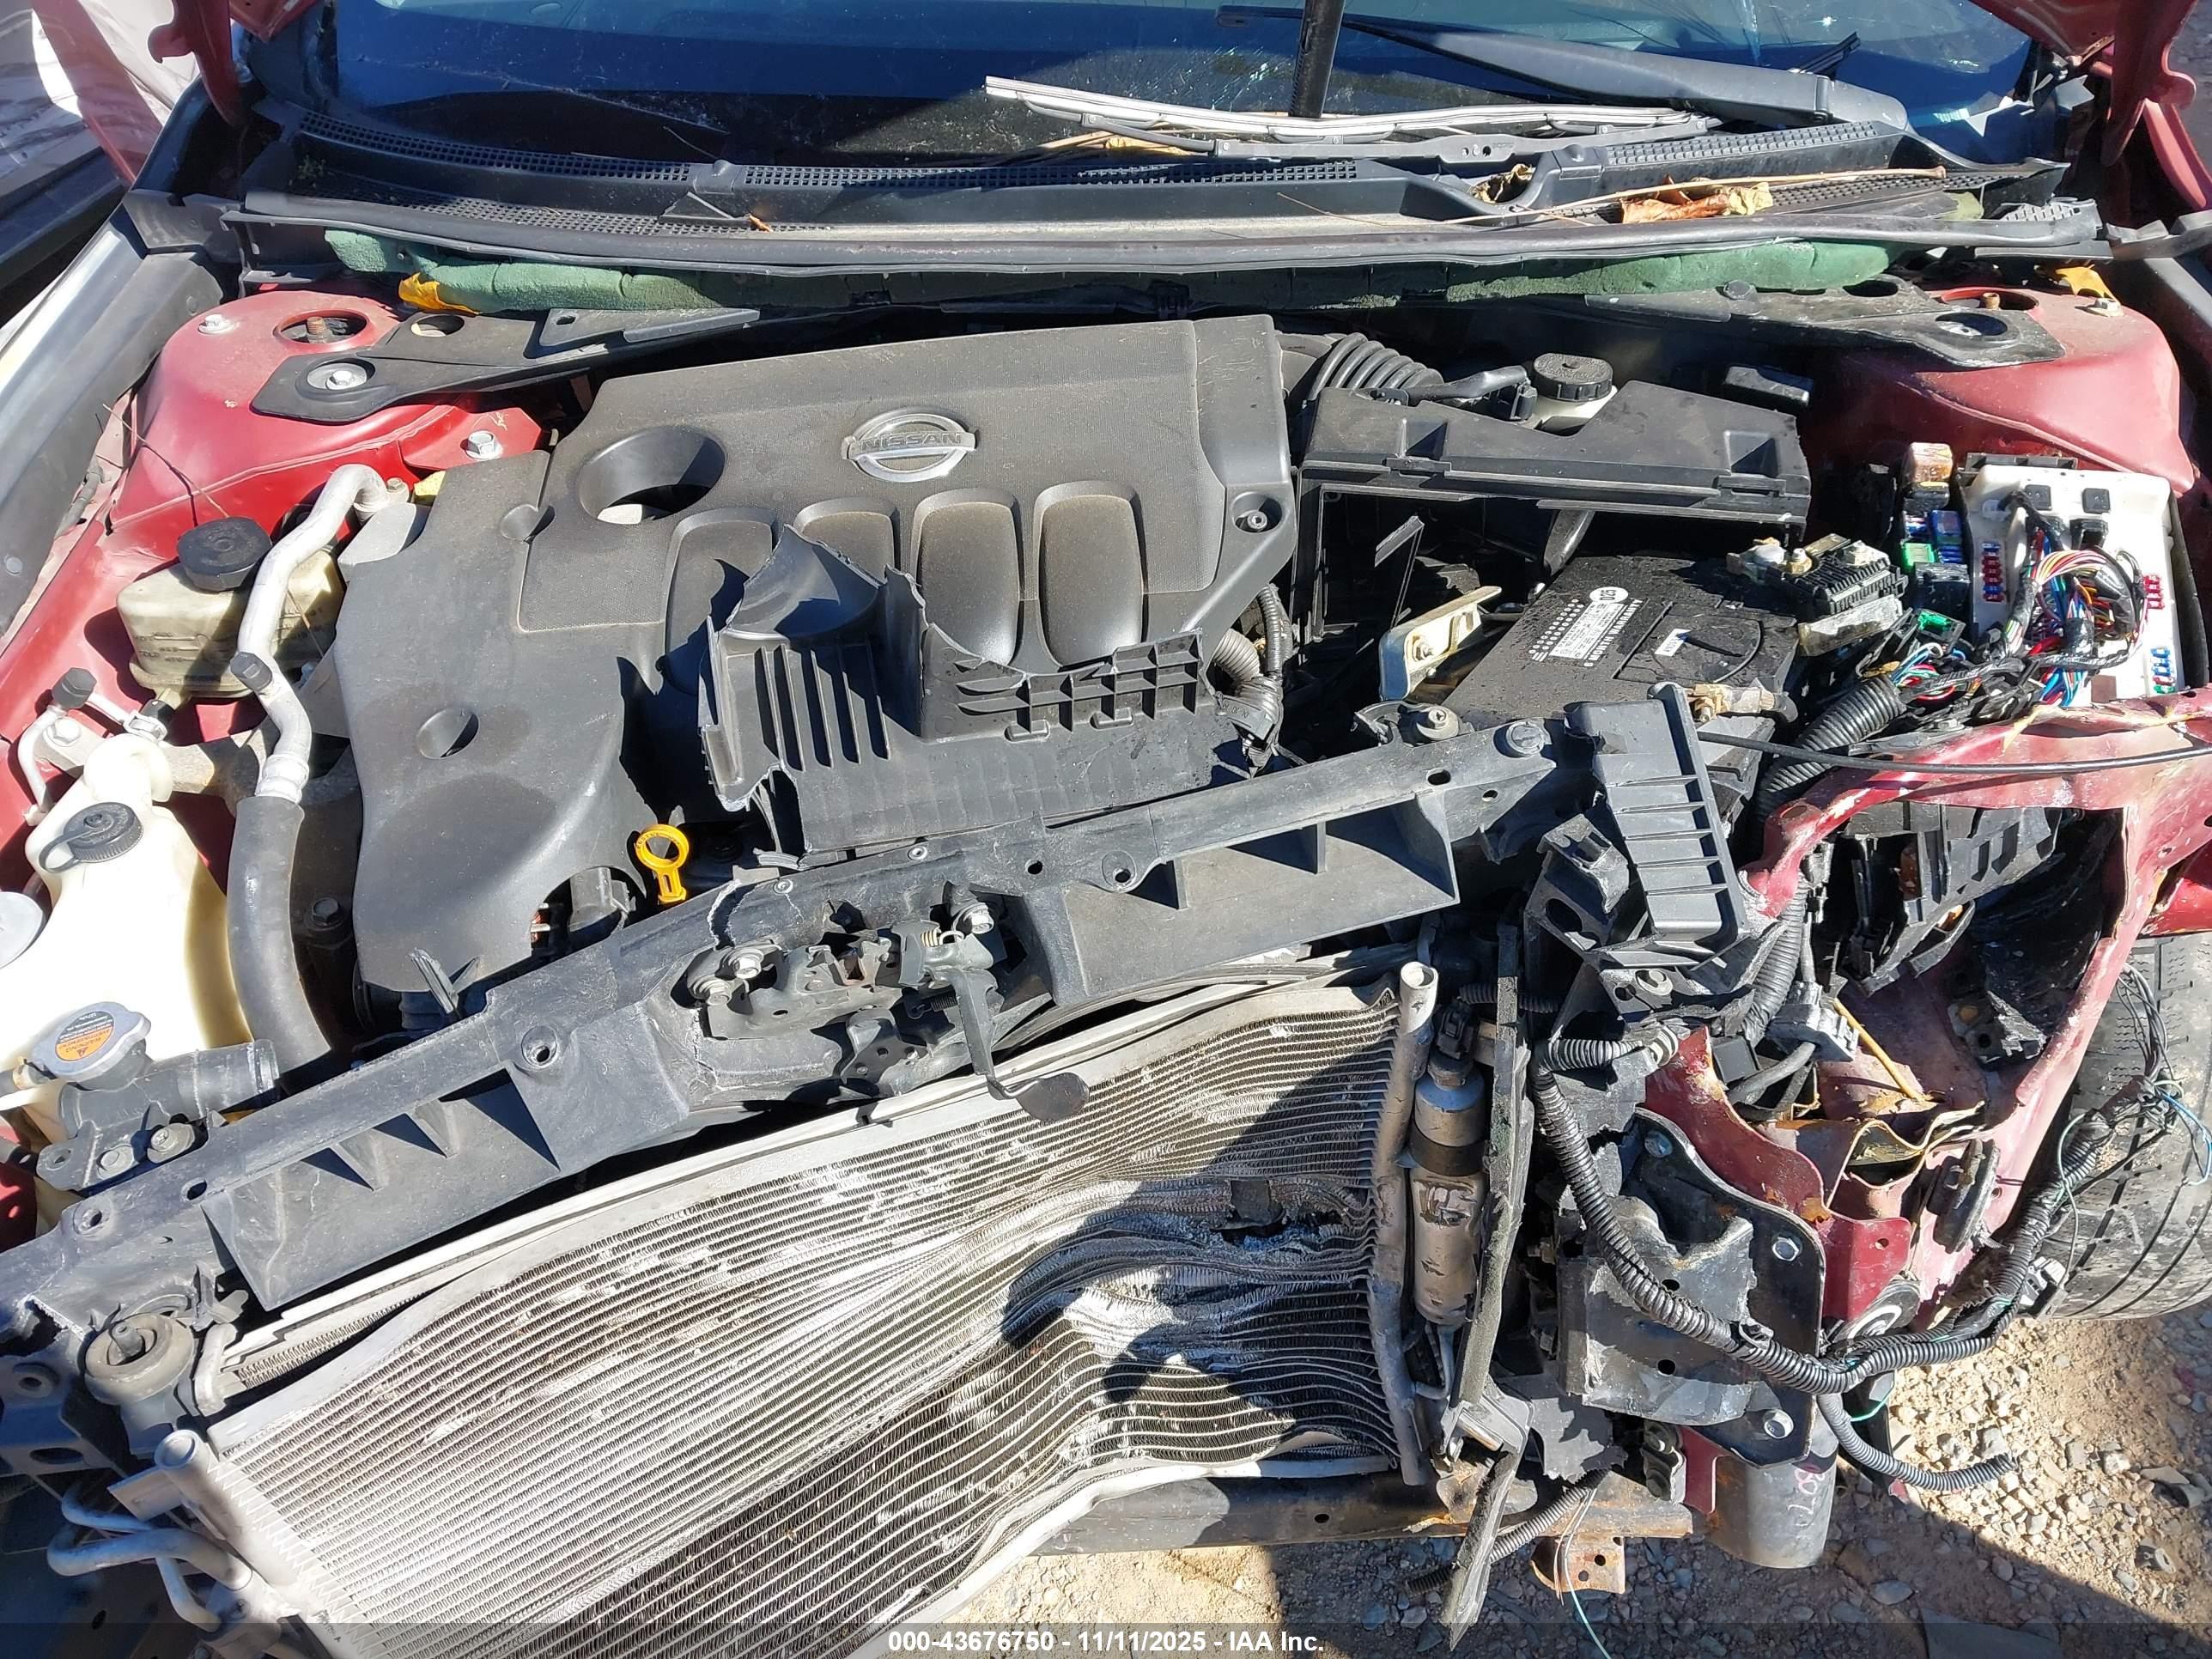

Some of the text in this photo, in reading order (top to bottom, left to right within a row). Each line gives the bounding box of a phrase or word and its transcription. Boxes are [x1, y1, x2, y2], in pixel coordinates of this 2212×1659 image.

[860, 432, 963, 452] NISSAN
[1588, 636, 1615, 661] MONTH
[1610, 598, 1644, 635] WARRANTY
